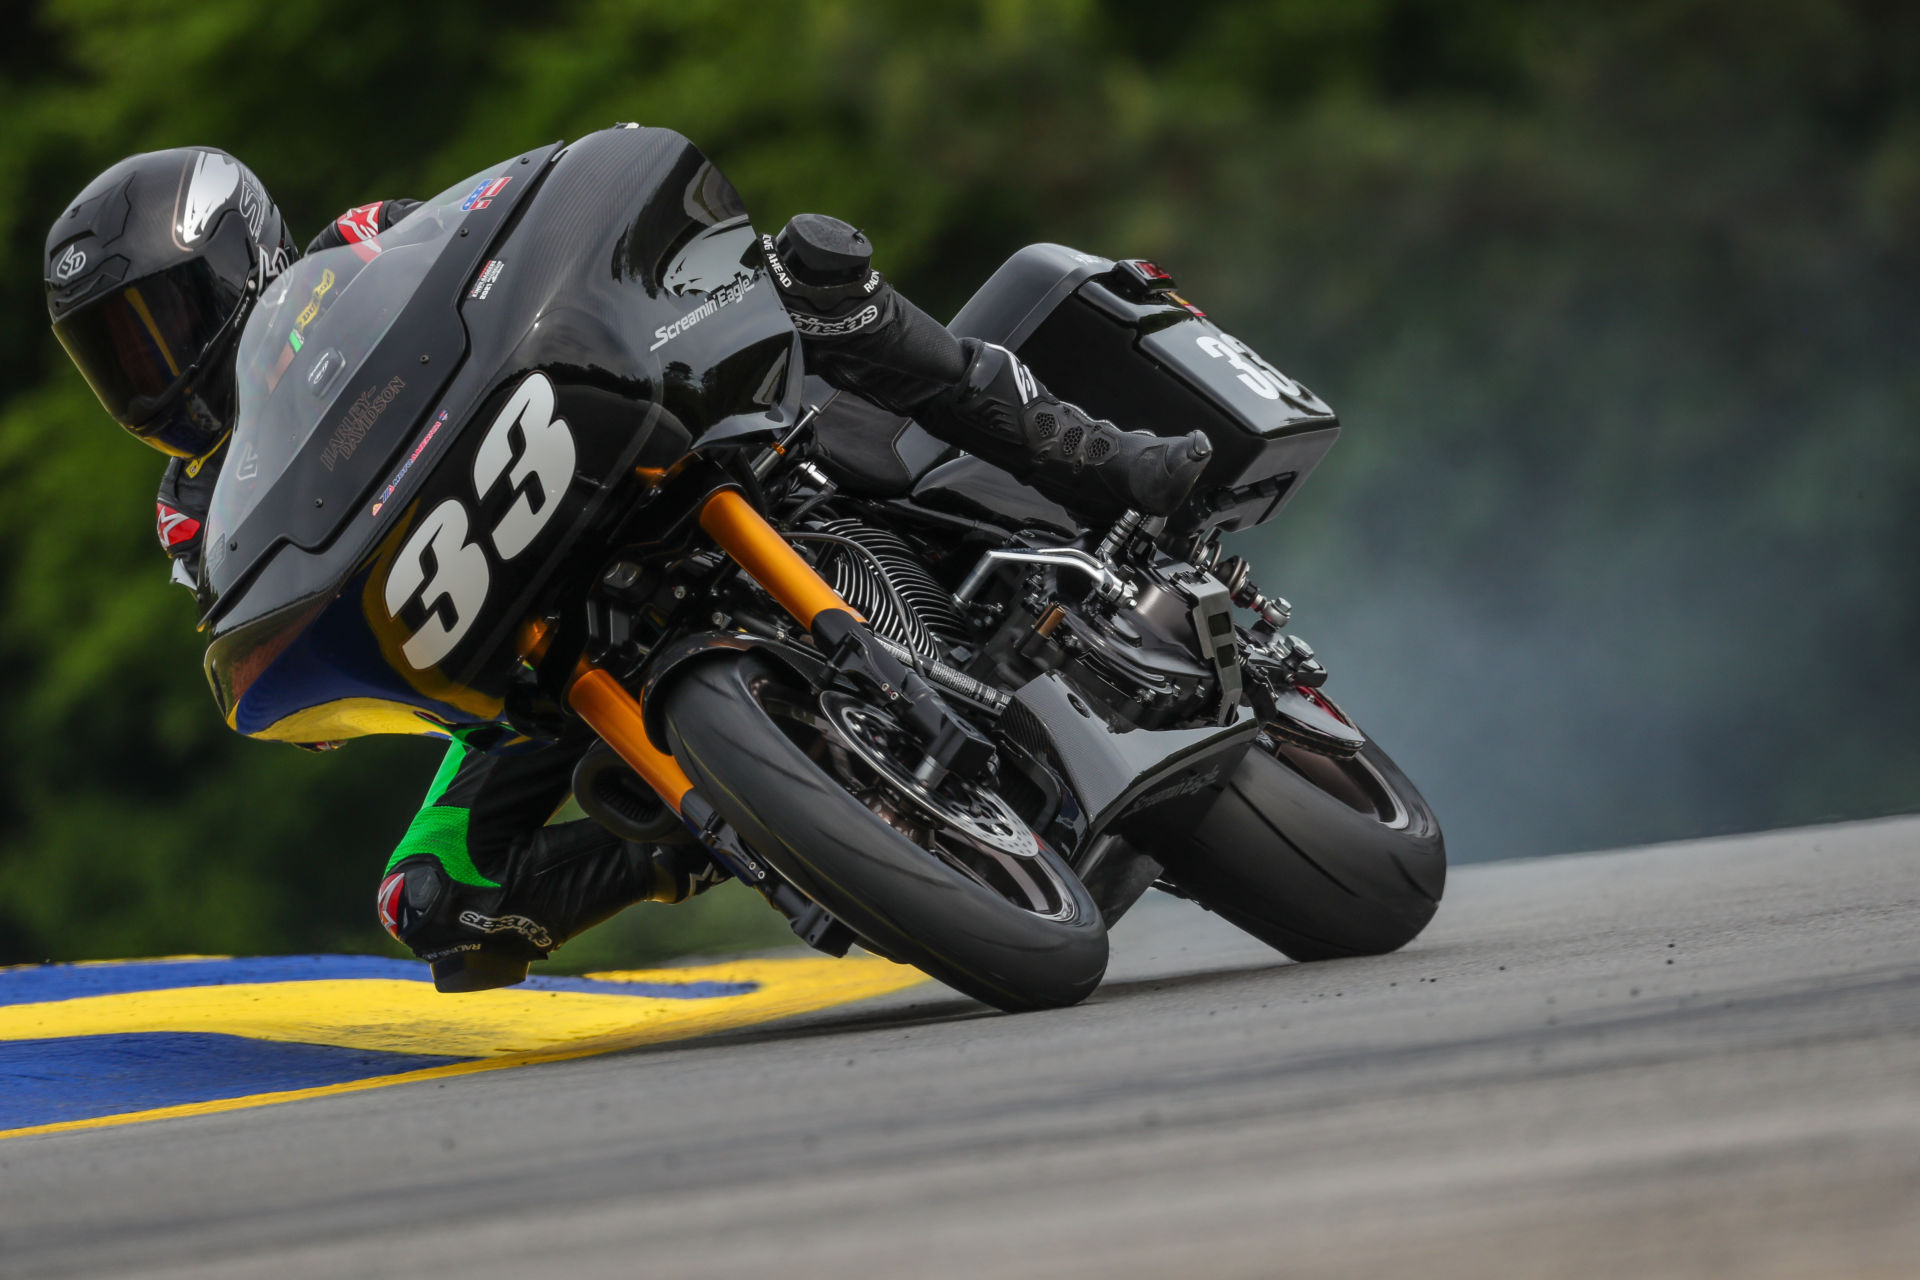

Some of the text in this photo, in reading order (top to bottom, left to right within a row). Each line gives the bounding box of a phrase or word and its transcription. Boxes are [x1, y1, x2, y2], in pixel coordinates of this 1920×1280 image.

[767, 253, 792, 288] AHEAD
[863, 269, 880, 293] RACIN
[717, 277, 755, 308] Eagle
[339, 375, 406, 460] DAVIDSON
[384, 372, 577, 671] 33
